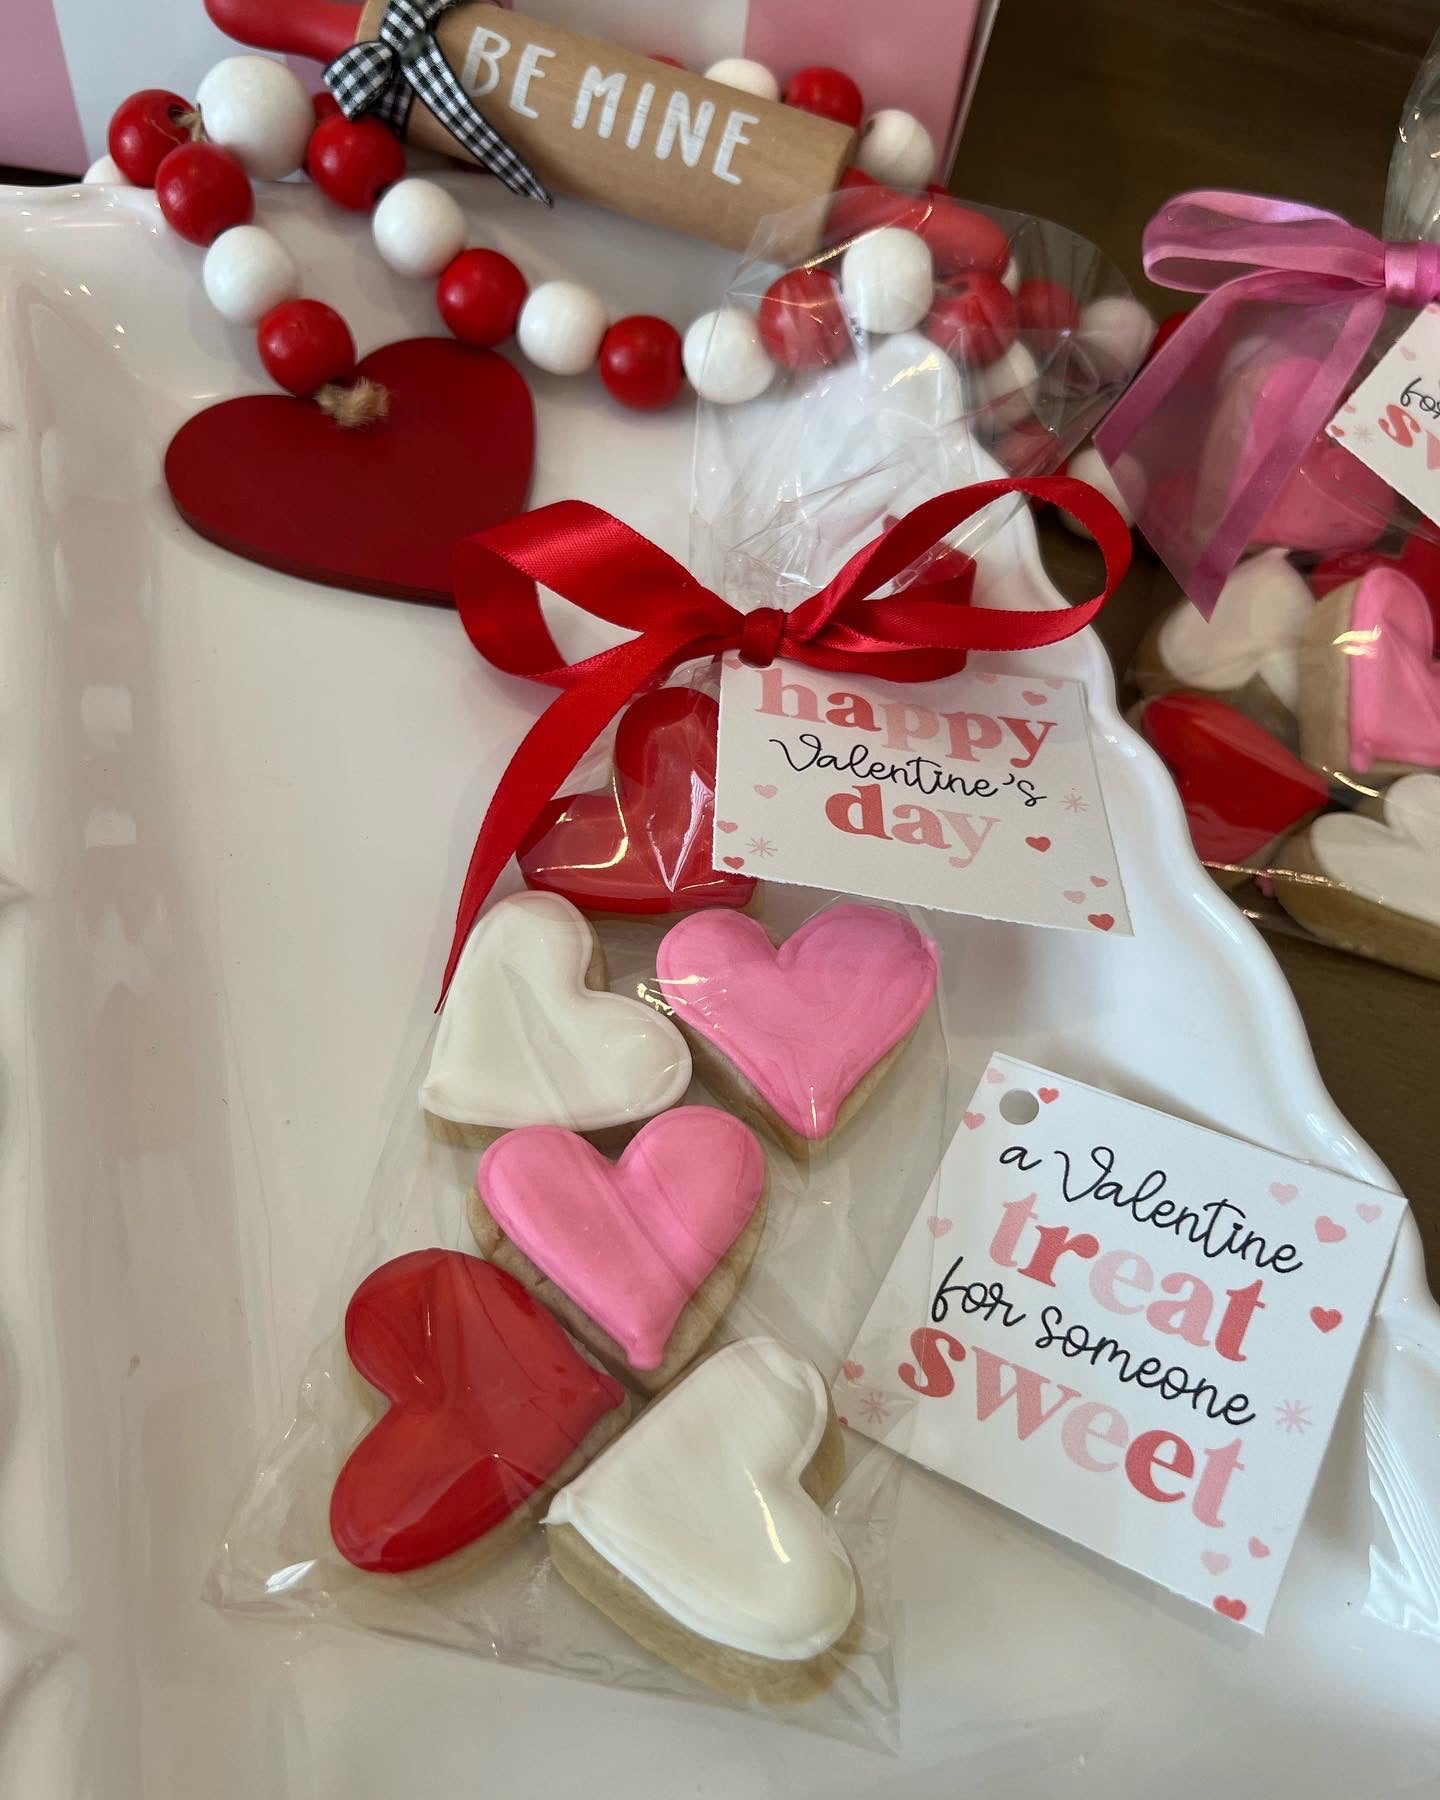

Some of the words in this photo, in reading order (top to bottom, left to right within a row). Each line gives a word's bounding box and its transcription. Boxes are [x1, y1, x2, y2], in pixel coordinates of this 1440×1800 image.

[463, 26, 556, 118] BE
[571, 65, 759, 185] MINE
[755, 668, 1057, 768] happy
[769, 733, 1047, 807] Valentine's
[825, 784, 1001, 868] day
[988, 1192, 1265, 1362] treat
[999, 1145, 1042, 1171] a
[1054, 1146, 1303, 1274] Valentine
[931, 1257, 1026, 1326] for
[1035, 1306, 1256, 1426] someone
[898, 1327, 1246, 1528] sweet
